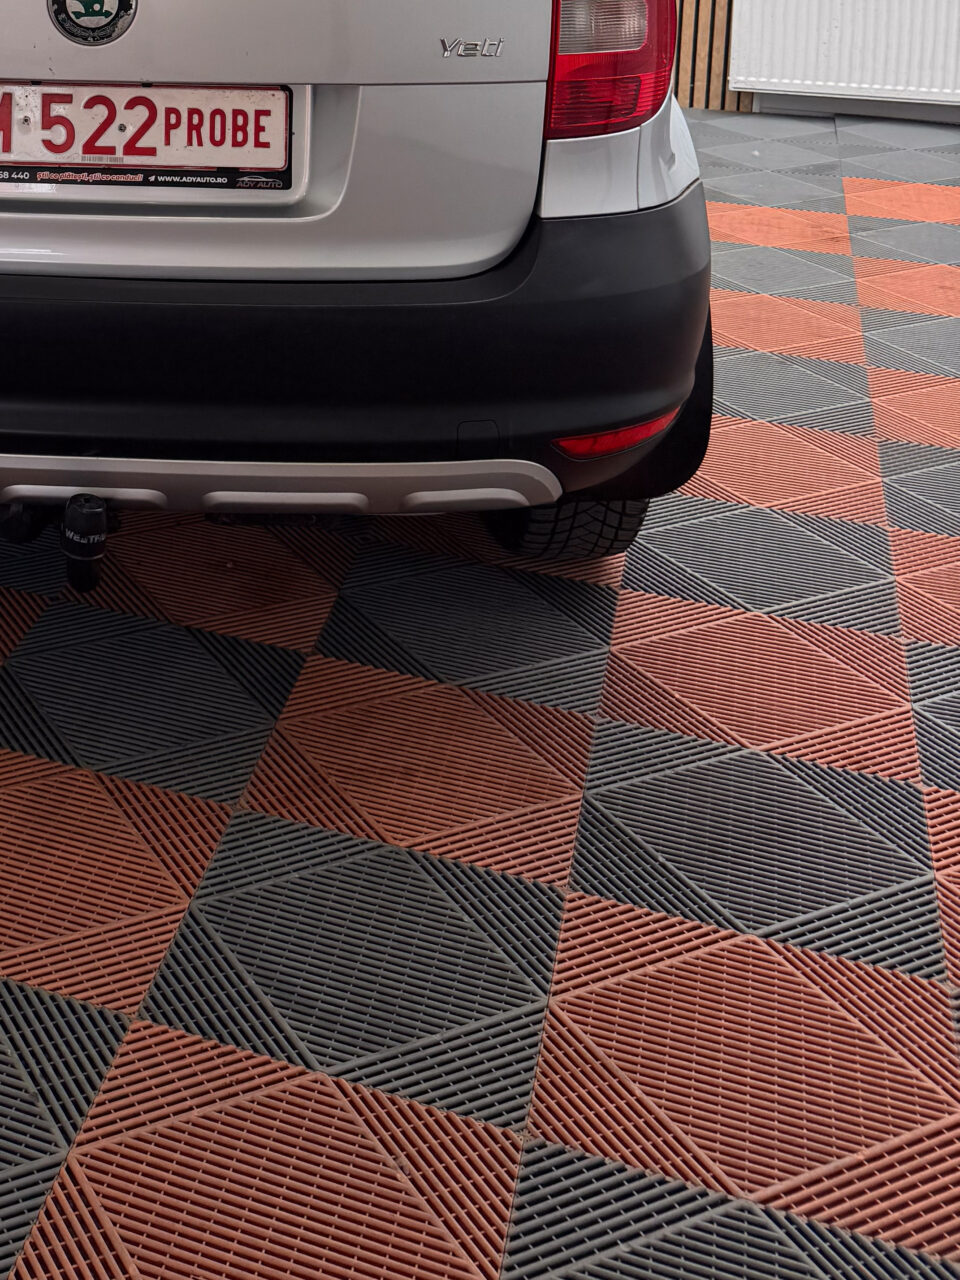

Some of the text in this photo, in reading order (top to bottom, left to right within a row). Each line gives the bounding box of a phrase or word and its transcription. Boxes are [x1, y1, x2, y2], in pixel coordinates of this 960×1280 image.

[440, 37, 504, 58] Yeti
[41, 93, 158, 157] 522
[164, 107, 272, 148] PROBE
[11, 172, 30, 180] 440
[157, 175, 228, 184] WWW.ADYAUTO.RO
[236, 179, 283, 188] ADY AUTO
